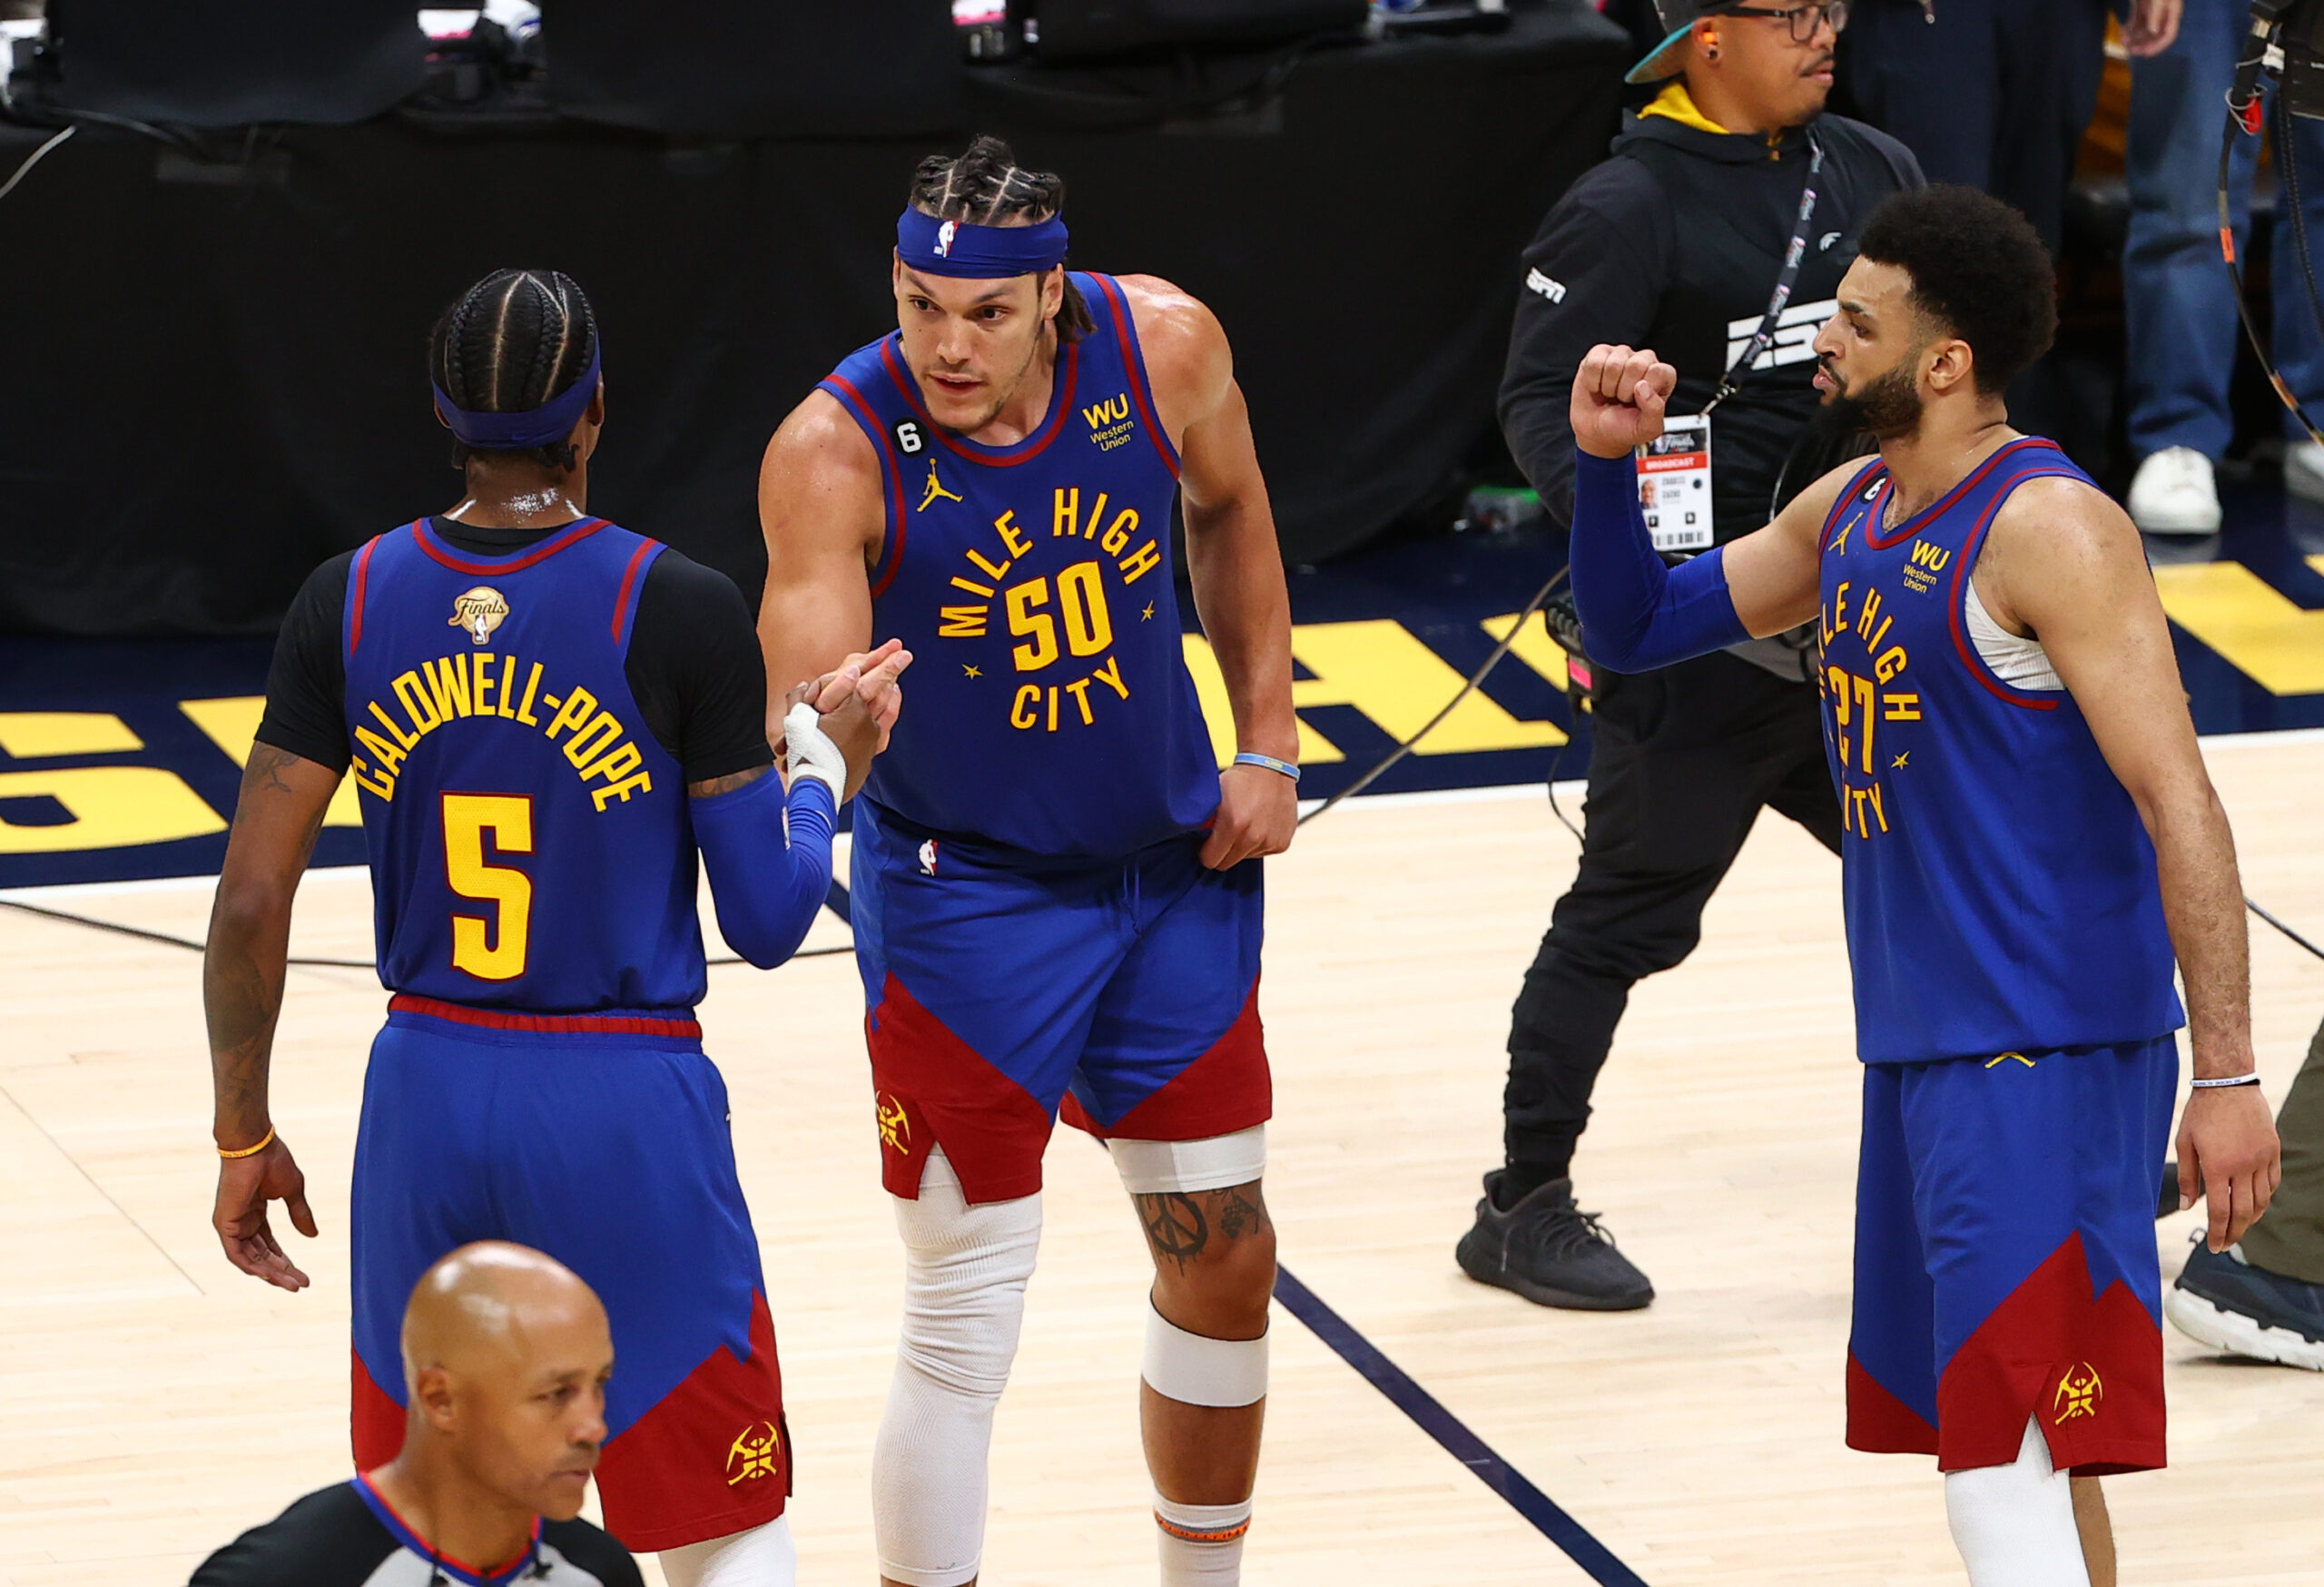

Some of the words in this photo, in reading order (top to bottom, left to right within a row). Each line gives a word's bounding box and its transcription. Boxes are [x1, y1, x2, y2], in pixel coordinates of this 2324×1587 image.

[1724, 298, 1841, 374] ES
[1081, 392, 1129, 429] WU
[1089, 420, 1135, 444] Western
[897, 421, 921, 455] 6
[1099, 434, 1131, 451] Union
[1864, 478, 1886, 500] 6
[938, 508, 1034, 638] MILE
[1052, 486, 1161, 586] HIGH
[1903, 563, 1937, 586] Western
[1910, 538, 1951, 571] WU
[1903, 576, 1927, 594] Union
[450, 597, 506, 624] Finals
[1004, 559, 1114, 673] 50
[1856, 587, 1922, 721] HIGH
[1009, 656, 1130, 733] CITY
[352, 652, 652, 812] CALDWELL-POPE
[1828, 665, 1876, 775] 27
[1842, 780, 1889, 840] ITY
[439, 791, 534, 983] 5
